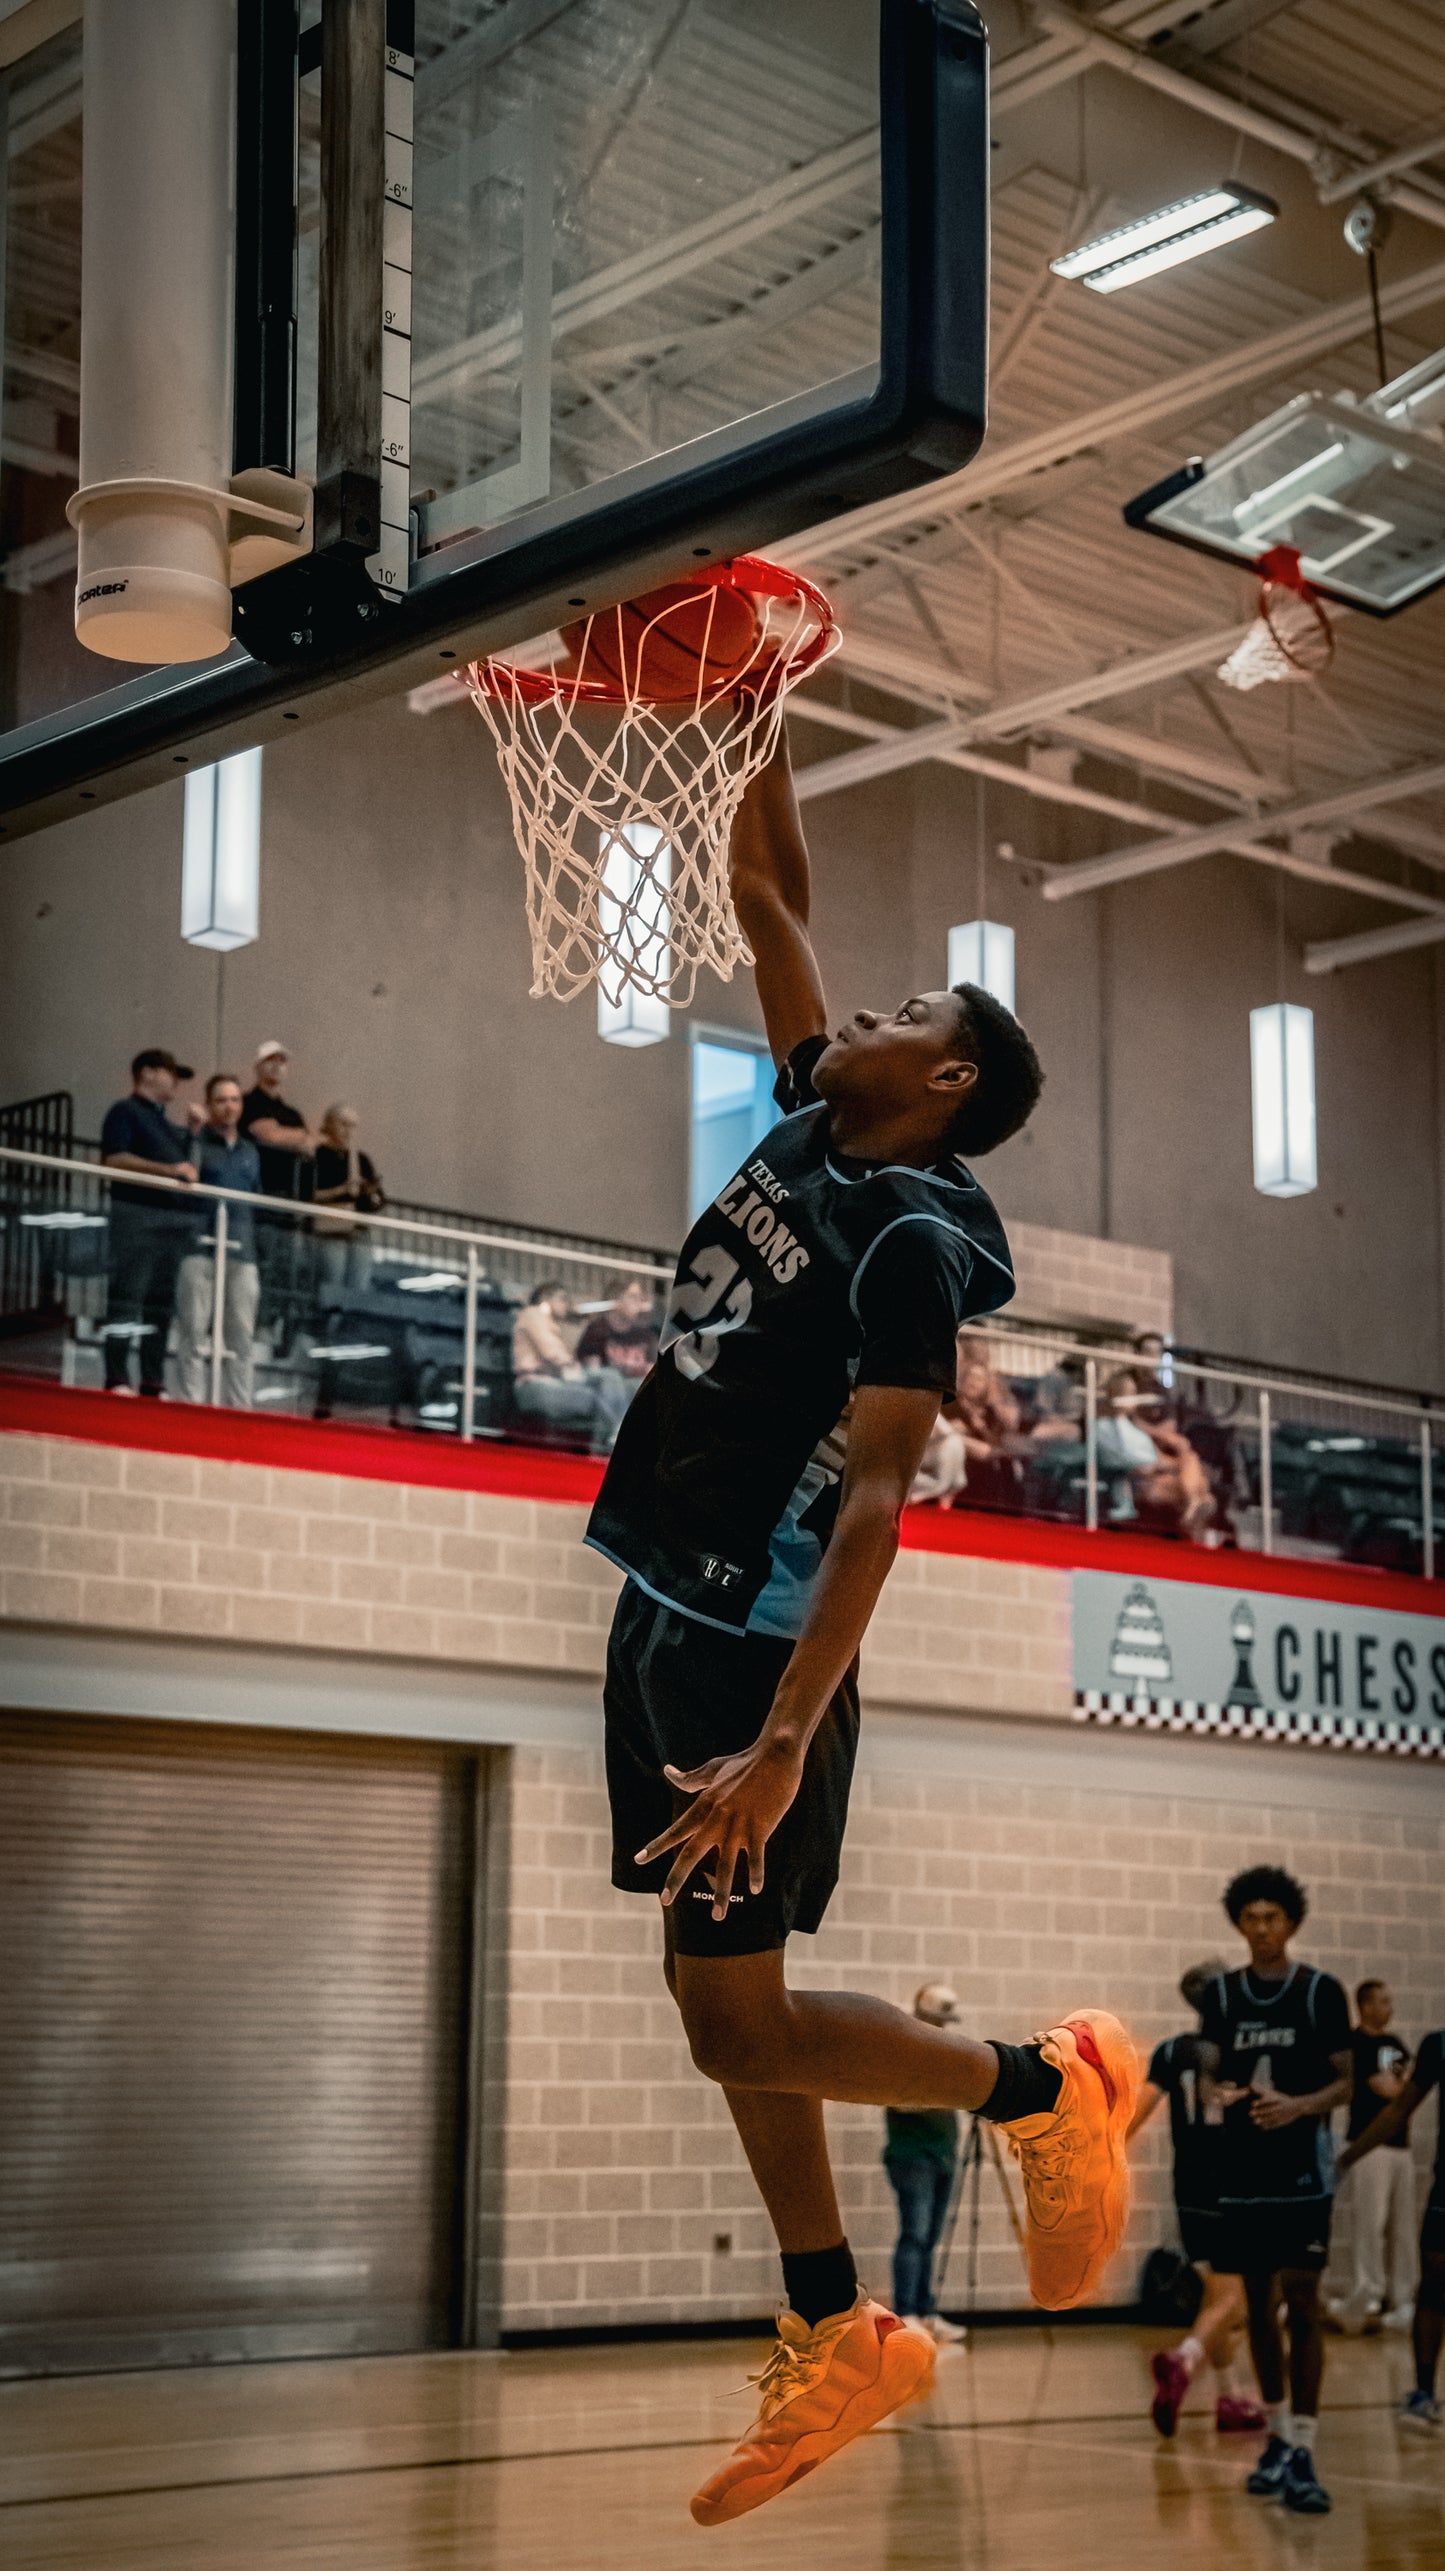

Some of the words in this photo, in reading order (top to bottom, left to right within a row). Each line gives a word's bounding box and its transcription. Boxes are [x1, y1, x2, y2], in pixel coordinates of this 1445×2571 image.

[388, 51, 401, 65] 8'
[385, 178, 408, 198] '-6"
[384, 310, 397, 324] 9'
[381, 438, 404, 457] '-6"
[377, 568, 397, 585] 10'
[747, 1158, 790, 1204] TEXAS
[714, 1174, 811, 1284] LIONS
[1275, 1623, 1445, 1718] CHESS
[692, 1891, 744, 1903] MONCH
